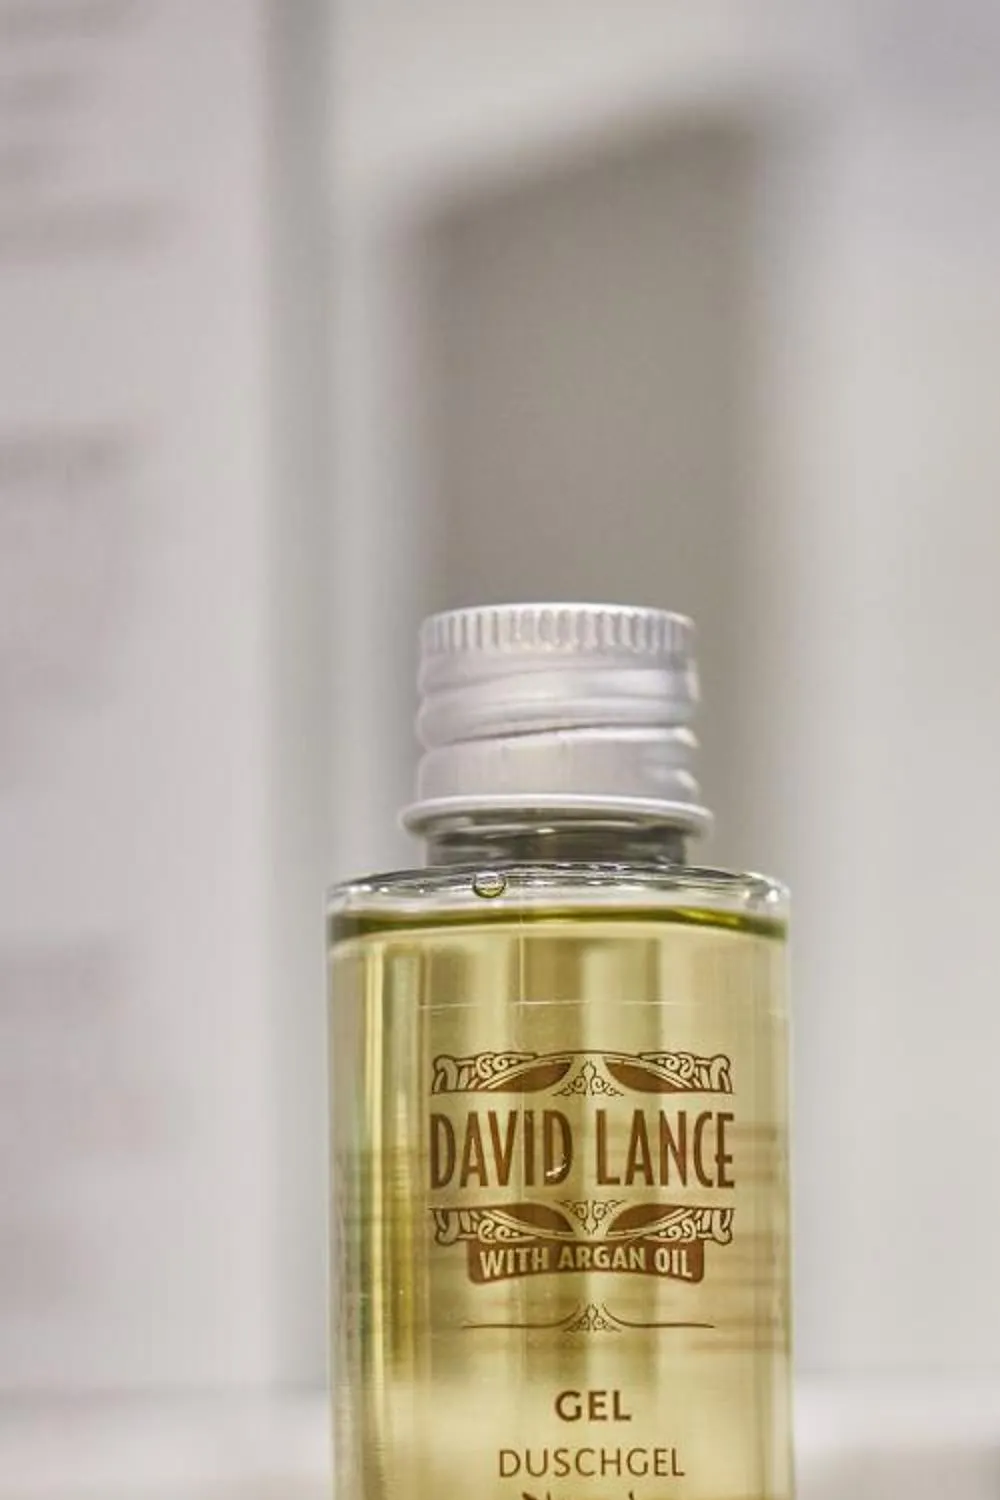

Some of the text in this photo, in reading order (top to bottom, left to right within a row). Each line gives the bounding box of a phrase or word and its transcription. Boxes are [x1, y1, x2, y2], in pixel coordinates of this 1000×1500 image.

[430, 1109, 735, 1188] DAVID LANCE
[480, 1247, 692, 1280] WITH ARGAN OIL
[555, 1390, 632, 1422] GEL
[499, 1448, 685, 1477] DUSCHGEL
